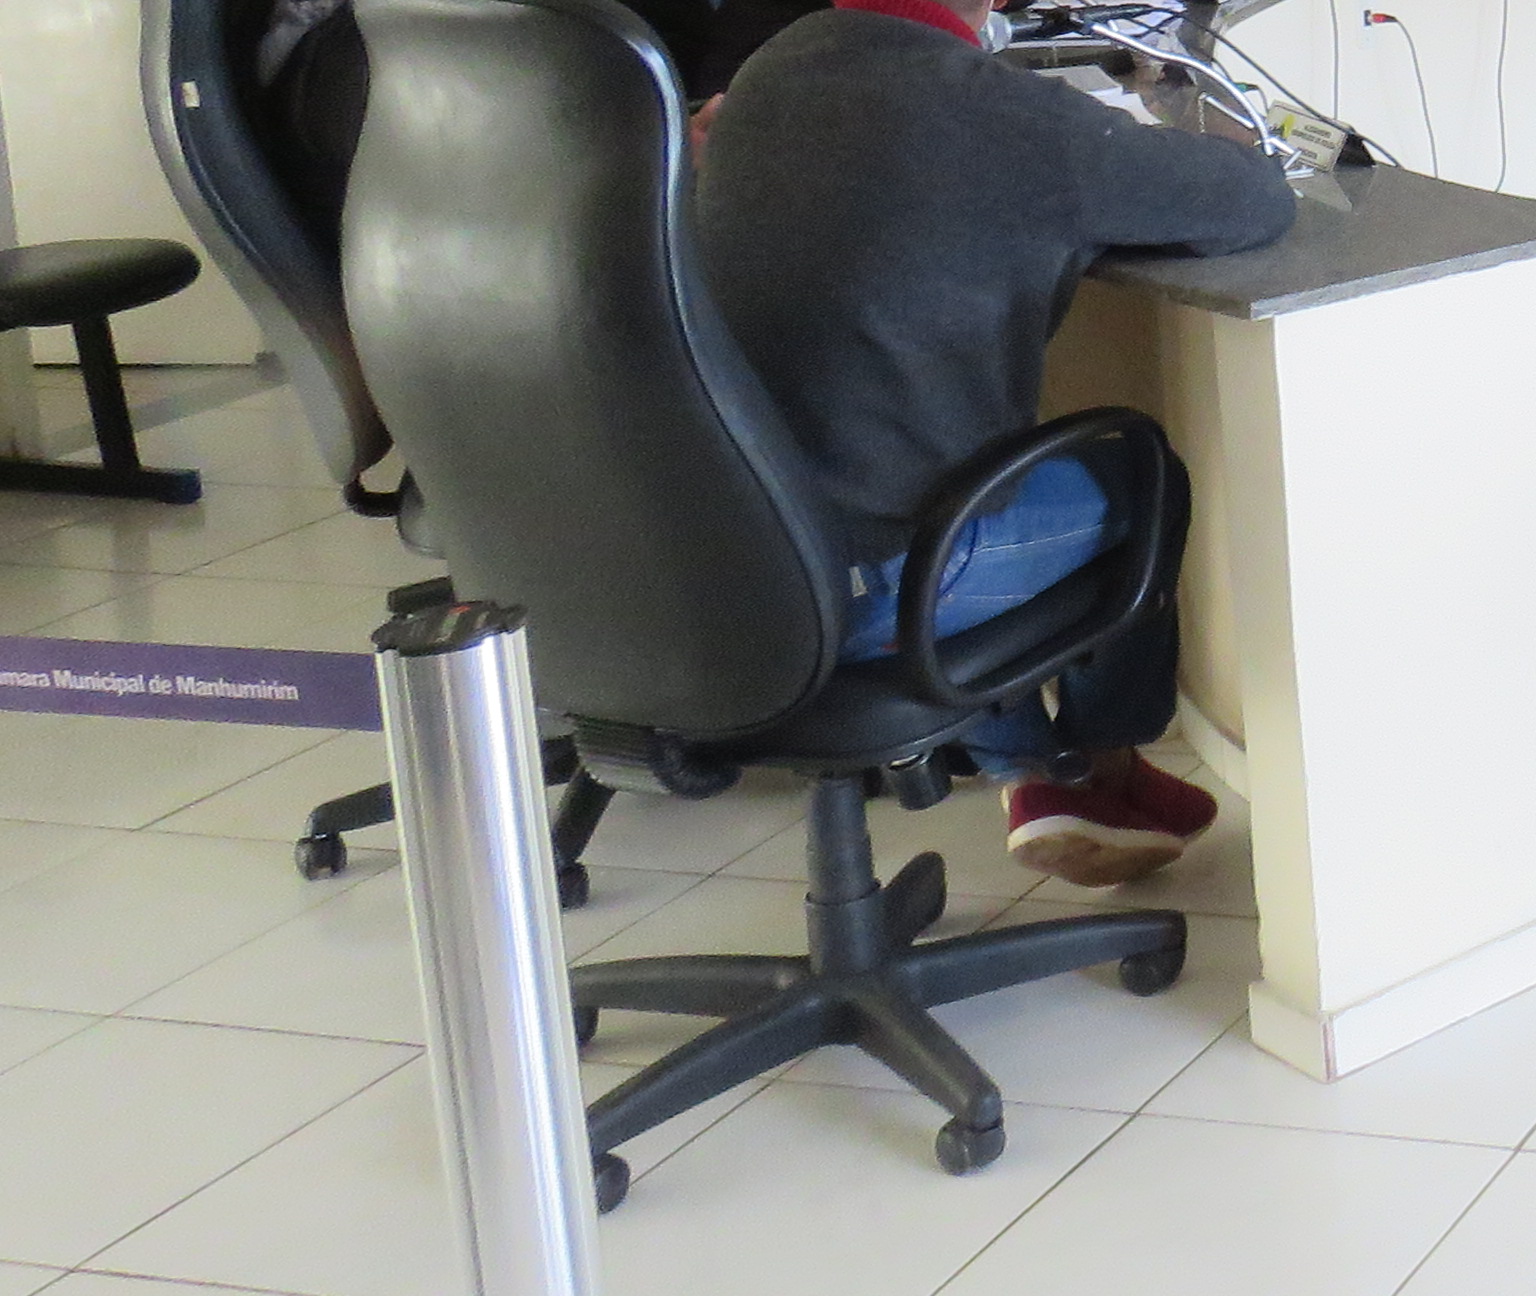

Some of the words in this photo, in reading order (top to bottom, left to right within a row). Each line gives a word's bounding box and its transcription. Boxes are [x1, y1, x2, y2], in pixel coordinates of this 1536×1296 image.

[53, 669, 144, 696] Municipal
[148, 674, 173, 694] de
[176, 675, 299, 701] Manhumirim
